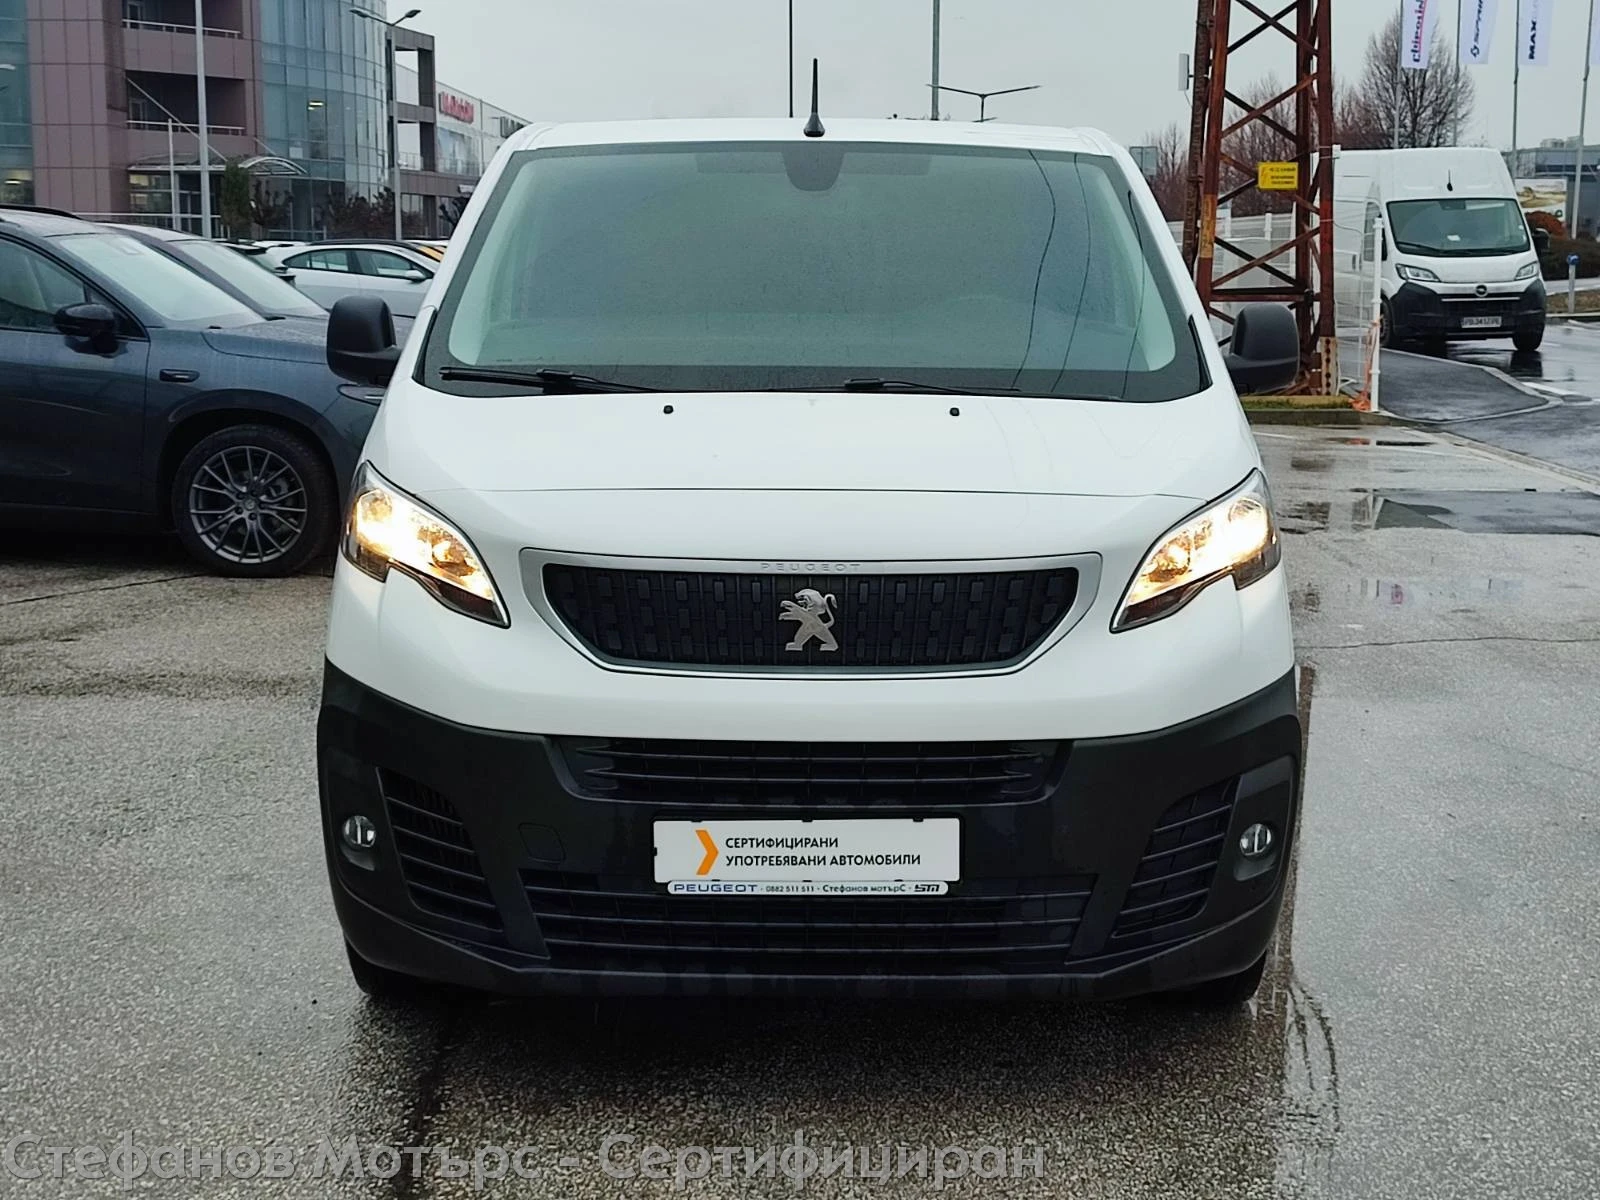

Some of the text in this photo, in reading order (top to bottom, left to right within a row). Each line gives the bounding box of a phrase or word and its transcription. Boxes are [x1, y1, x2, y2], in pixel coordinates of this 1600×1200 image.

[761, 563, 861, 572] PEUGEOT
[725, 837, 839, 850] СЕРТИФИЦИРАНИ
[725, 854, 921, 867] УПОТРЕБЯВАНИ АВТОМОБИЛИ
[673, 884, 758, 893] PEUGEOT
[822, 884, 869, 894] Стефанов
